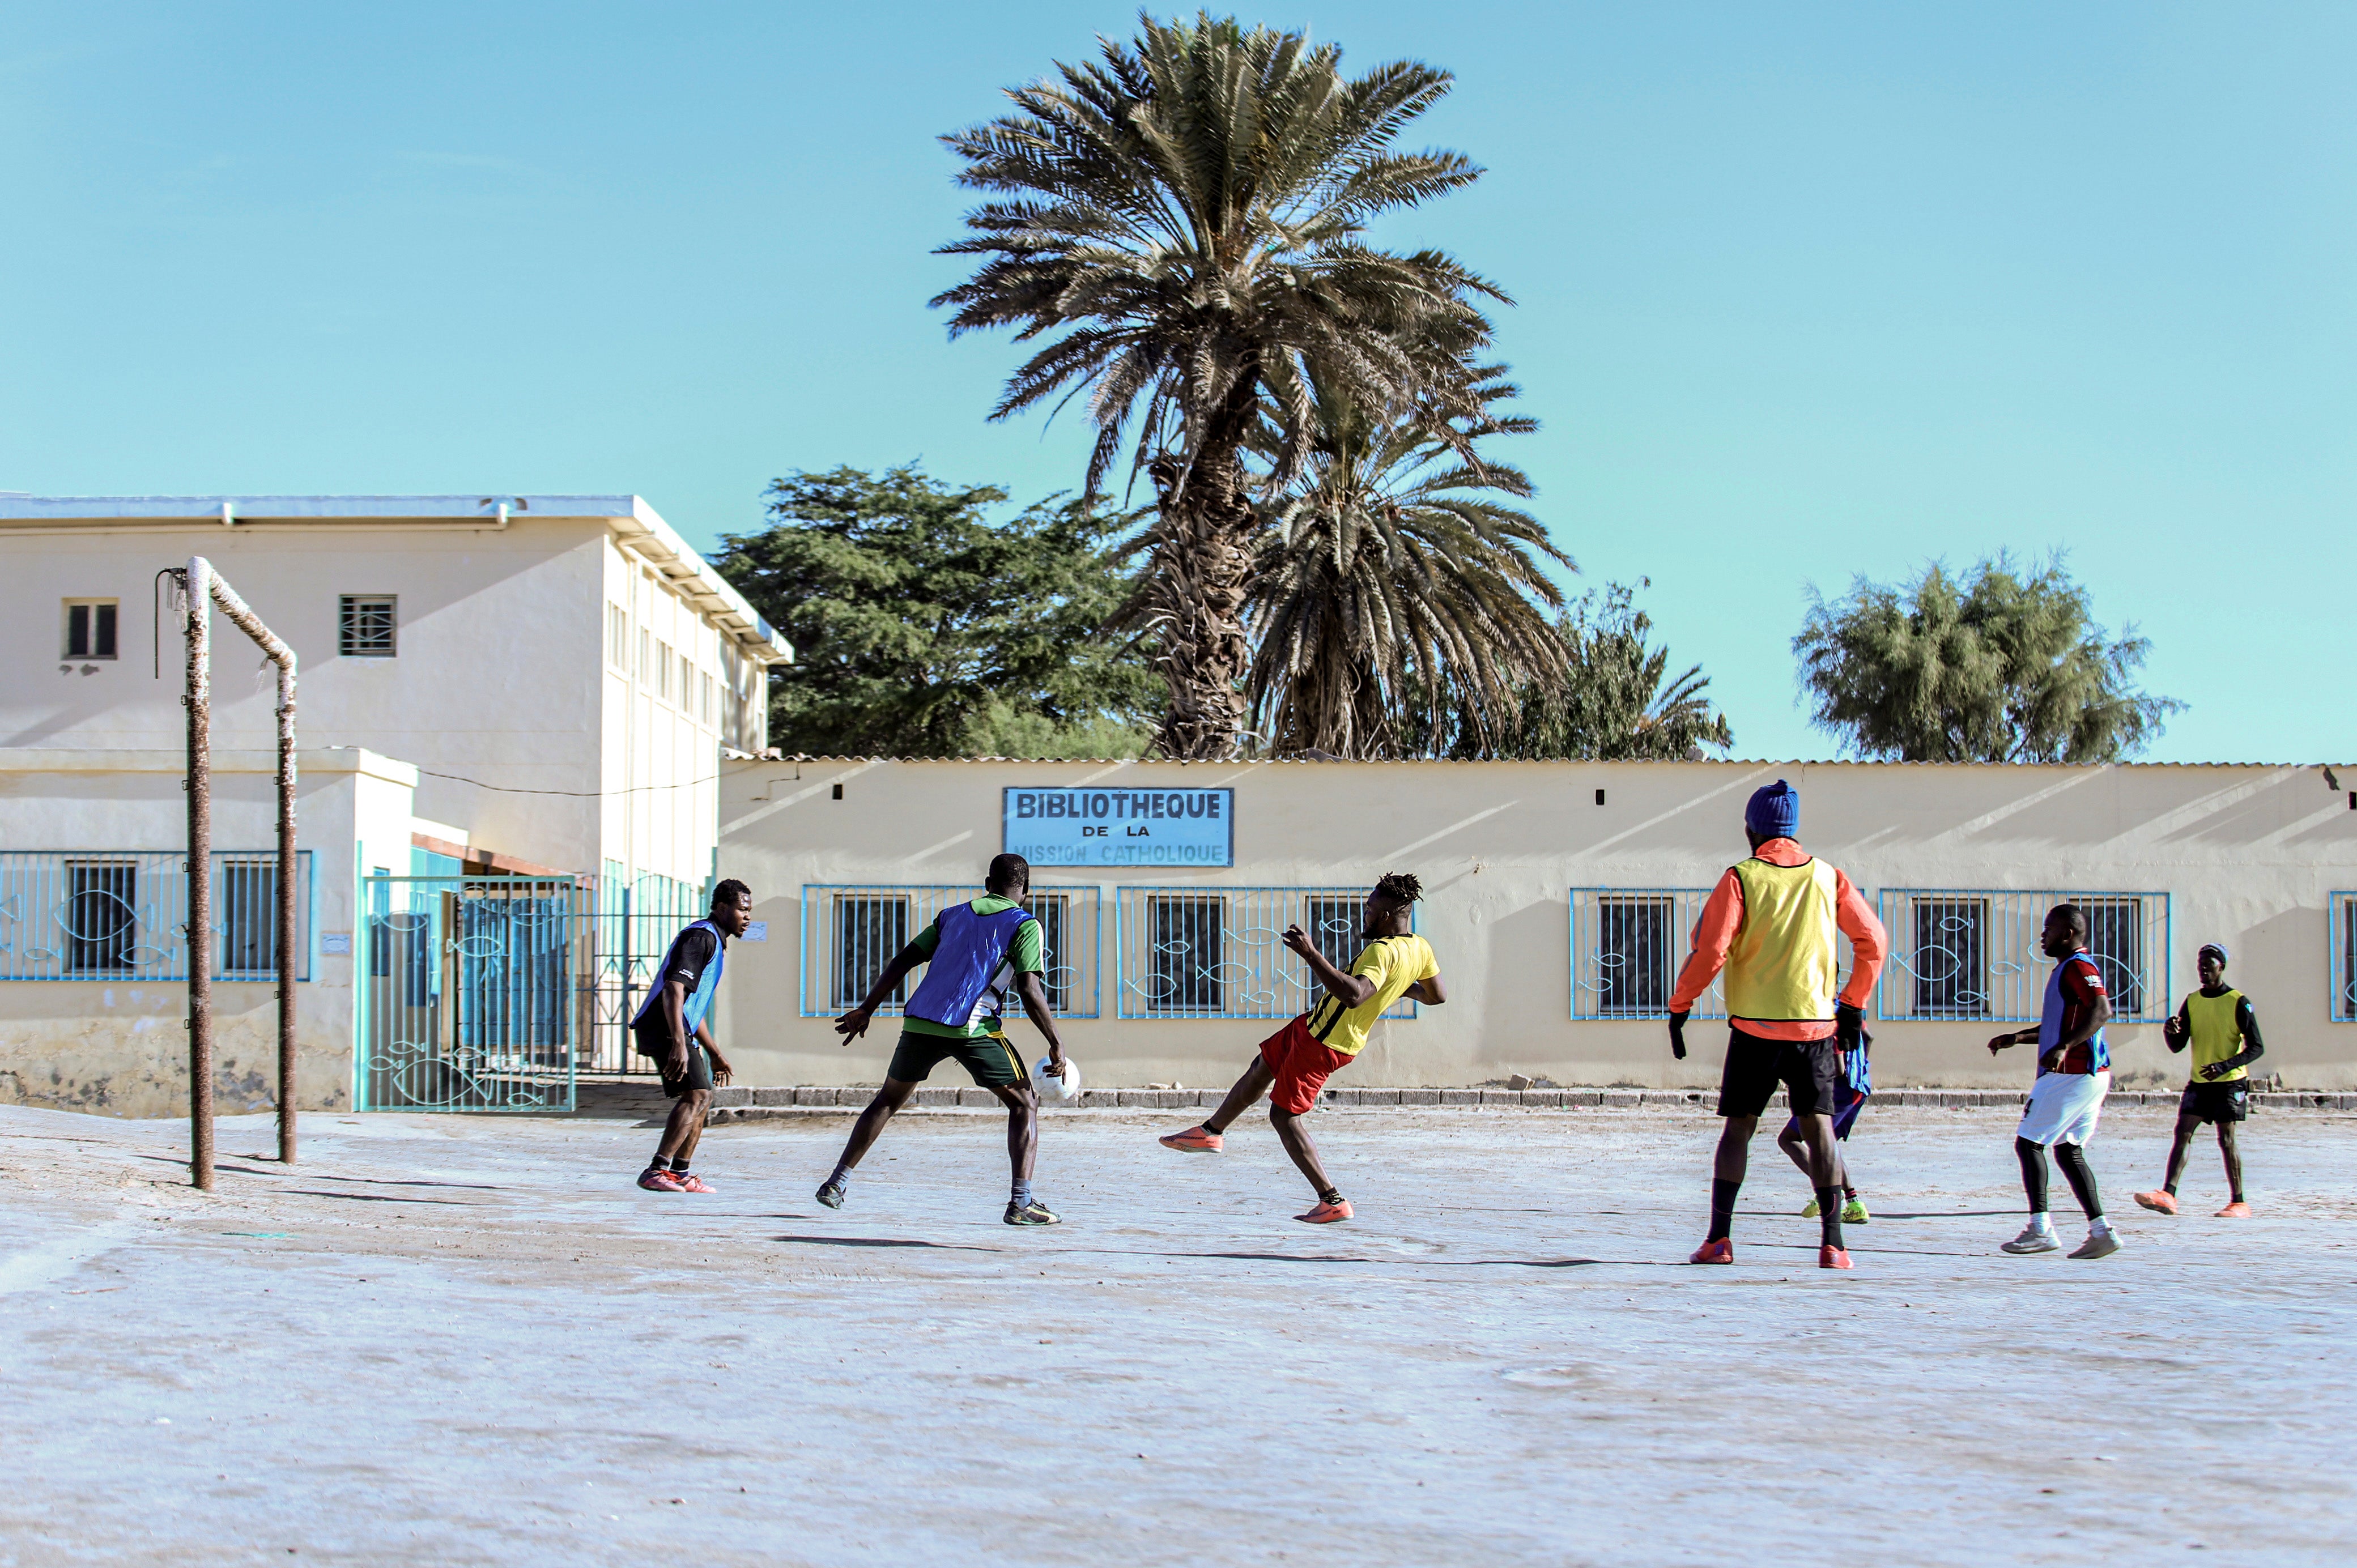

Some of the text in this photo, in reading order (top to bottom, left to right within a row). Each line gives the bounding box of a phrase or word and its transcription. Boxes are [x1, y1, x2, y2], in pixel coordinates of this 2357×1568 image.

[1017, 794, 1220, 819] BIBLIOTHEQUE
[1083, 826, 1150, 837] DE LA
[1101, 845, 1223, 862] CATHOLIQUE
